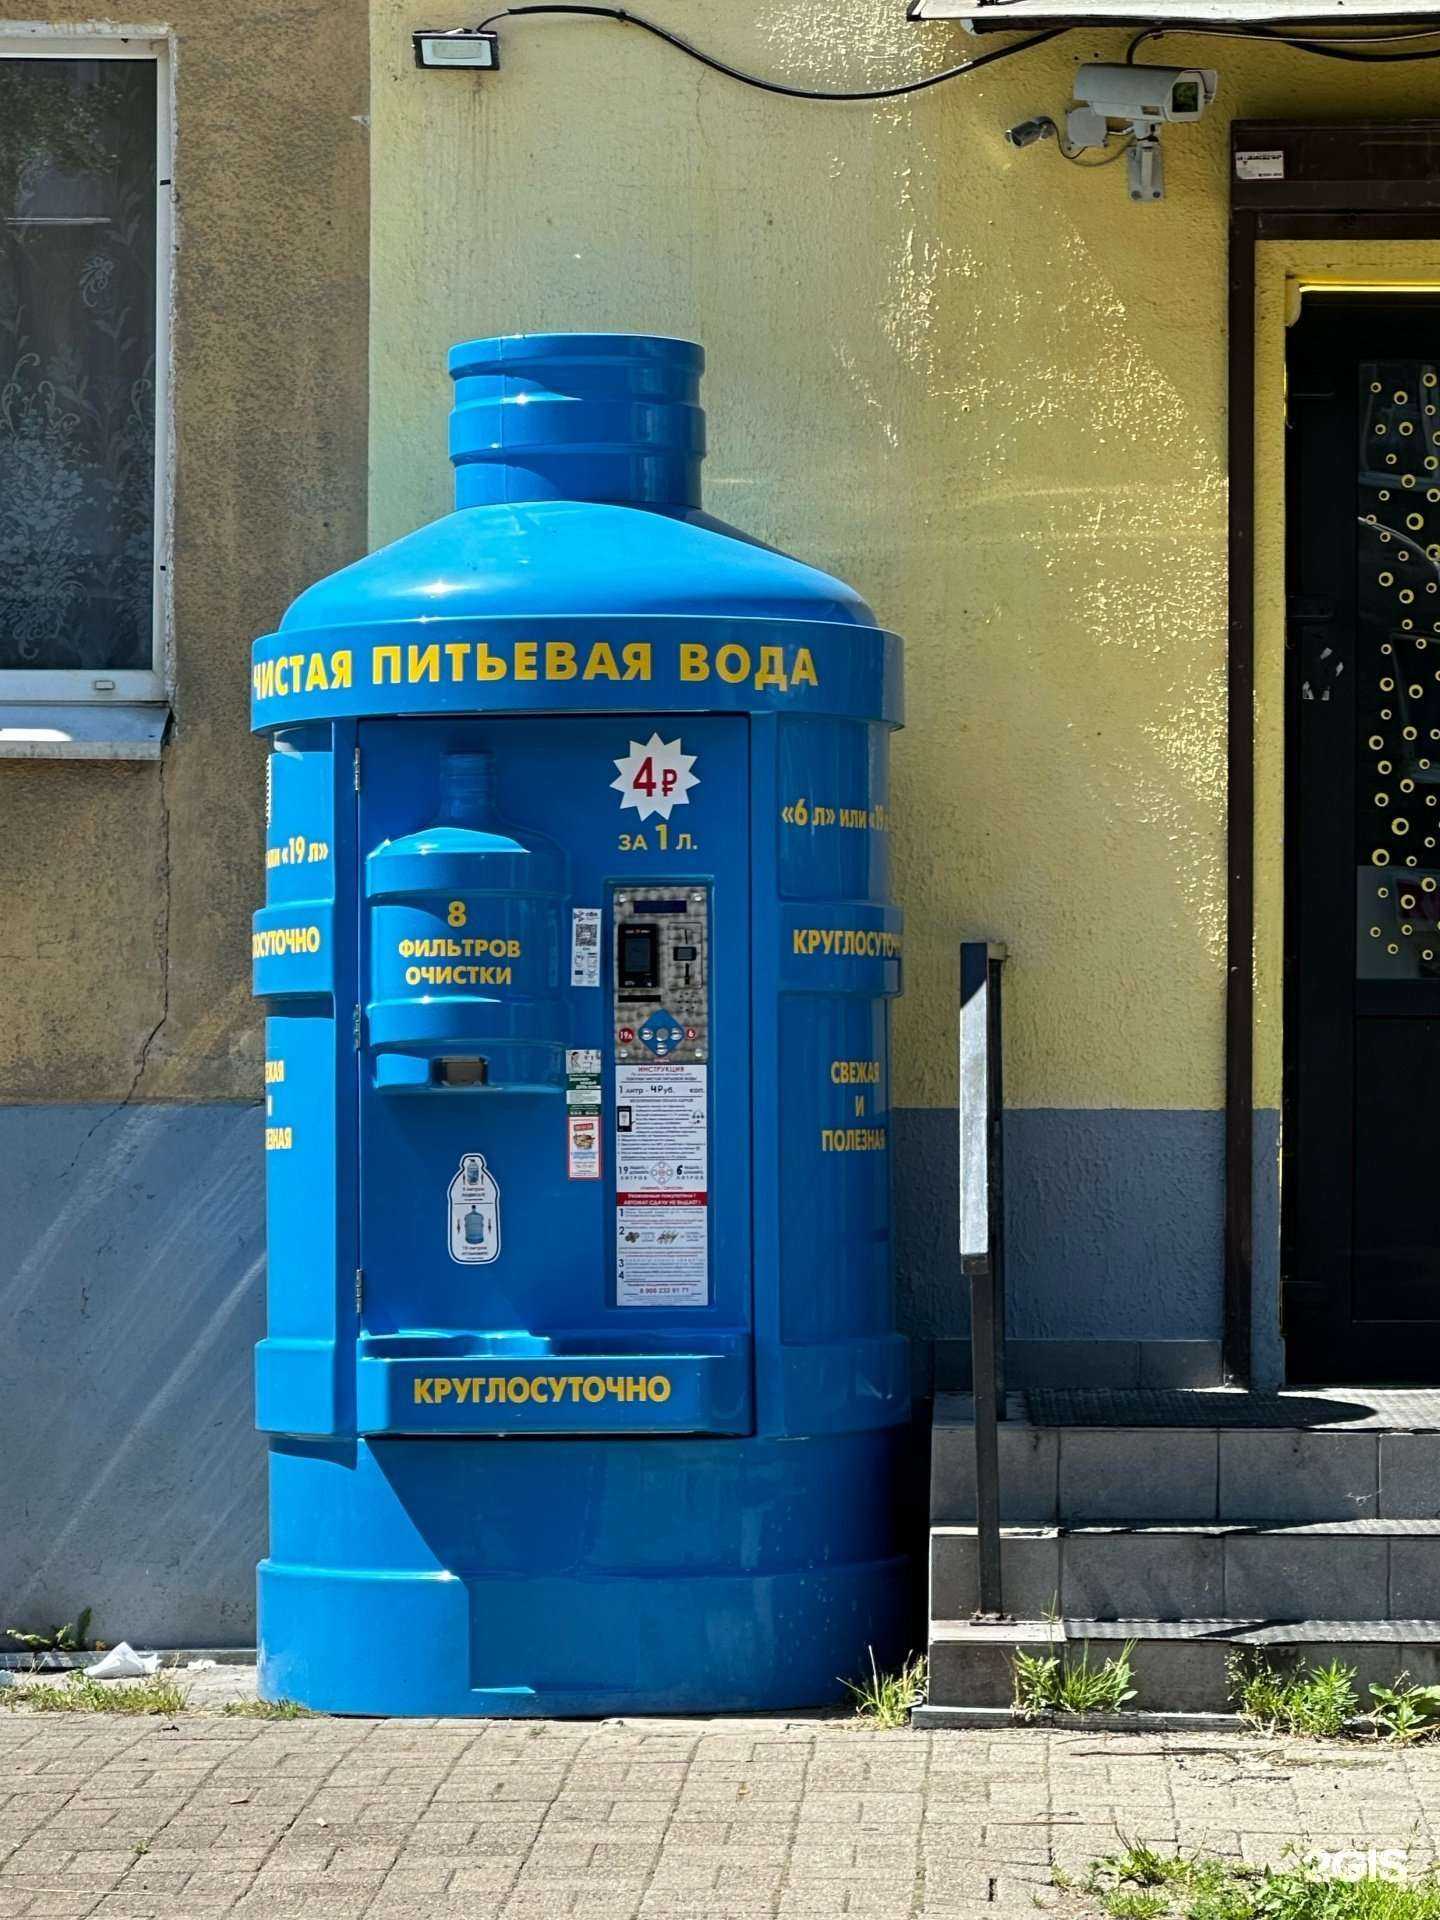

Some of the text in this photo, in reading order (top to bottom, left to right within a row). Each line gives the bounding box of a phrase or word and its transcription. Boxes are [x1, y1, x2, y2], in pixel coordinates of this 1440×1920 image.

[252, 642, 818, 700] ЧИСТАЯ ПИТЬЕВАЯ ВОДА
[655, 823, 668, 850] 1
[448, 900, 467, 927] 8
[398, 938, 521, 958] ФИЛЬТРОВ
[405, 965, 512, 985] ОЧИСТКИ
[831, 1061, 880, 1084] СВЕЖАЯ
[855, 1095, 864, 1117] И
[821, 1129, 886, 1152] ПОЛЕЗНАЯ
[619, 1166, 628, 1175] 19
[676, 1164, 683, 1175] 6
[619, 1226, 625, 1235] 2
[618, 1258, 624, 1267] 3
[618, 1271, 624, 1280] 4
[414, 1376, 671, 1404] КРУГЛОСУТОЧНО
